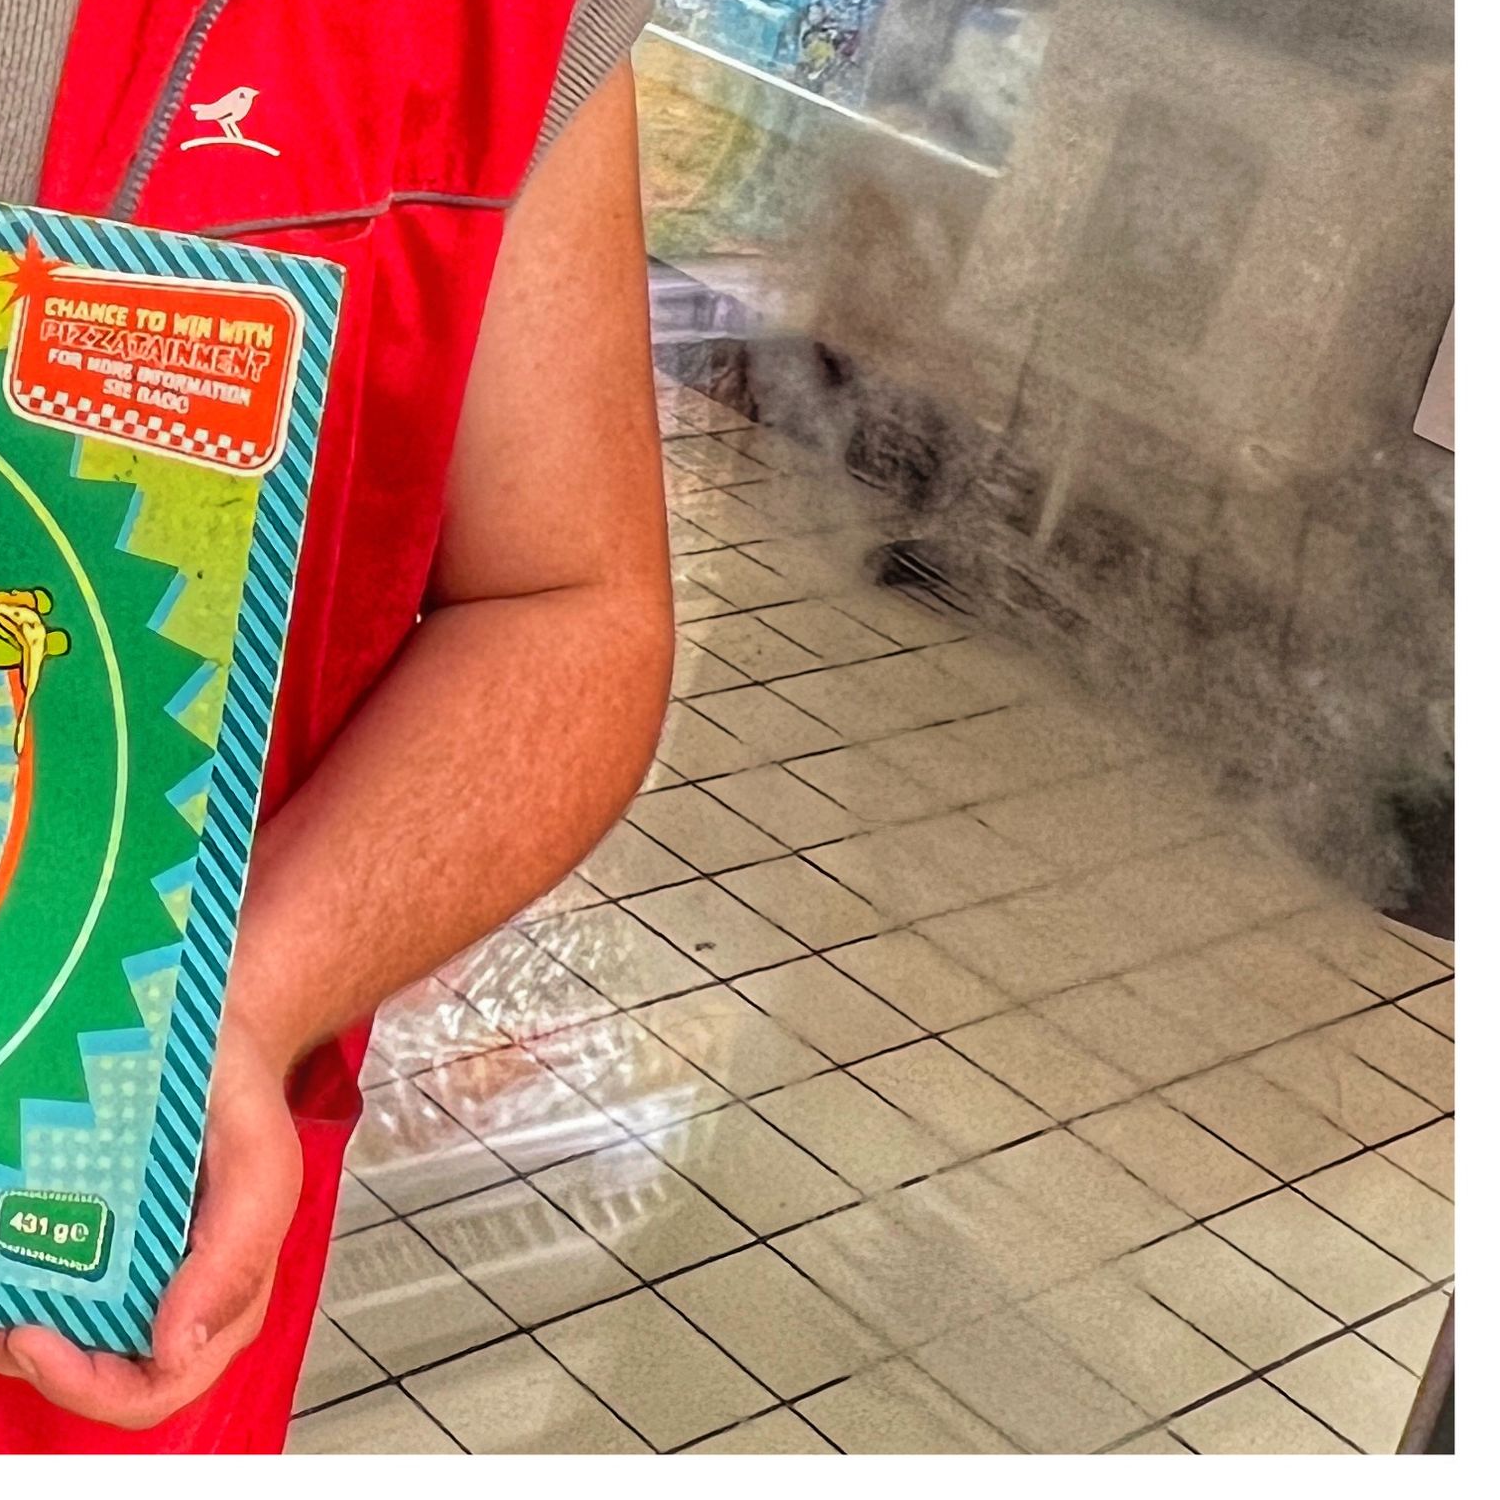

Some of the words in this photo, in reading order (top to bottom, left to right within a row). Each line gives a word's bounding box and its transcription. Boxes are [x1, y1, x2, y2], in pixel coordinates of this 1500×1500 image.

[44, 297, 130, 328] CHANCE
[135, 307, 167, 333] TO
[173, 312, 213, 340] WIN
[218, 317, 274, 349] WITH
[48, 348, 83, 371] FOR
[9, 1211, 48, 1236] 431
